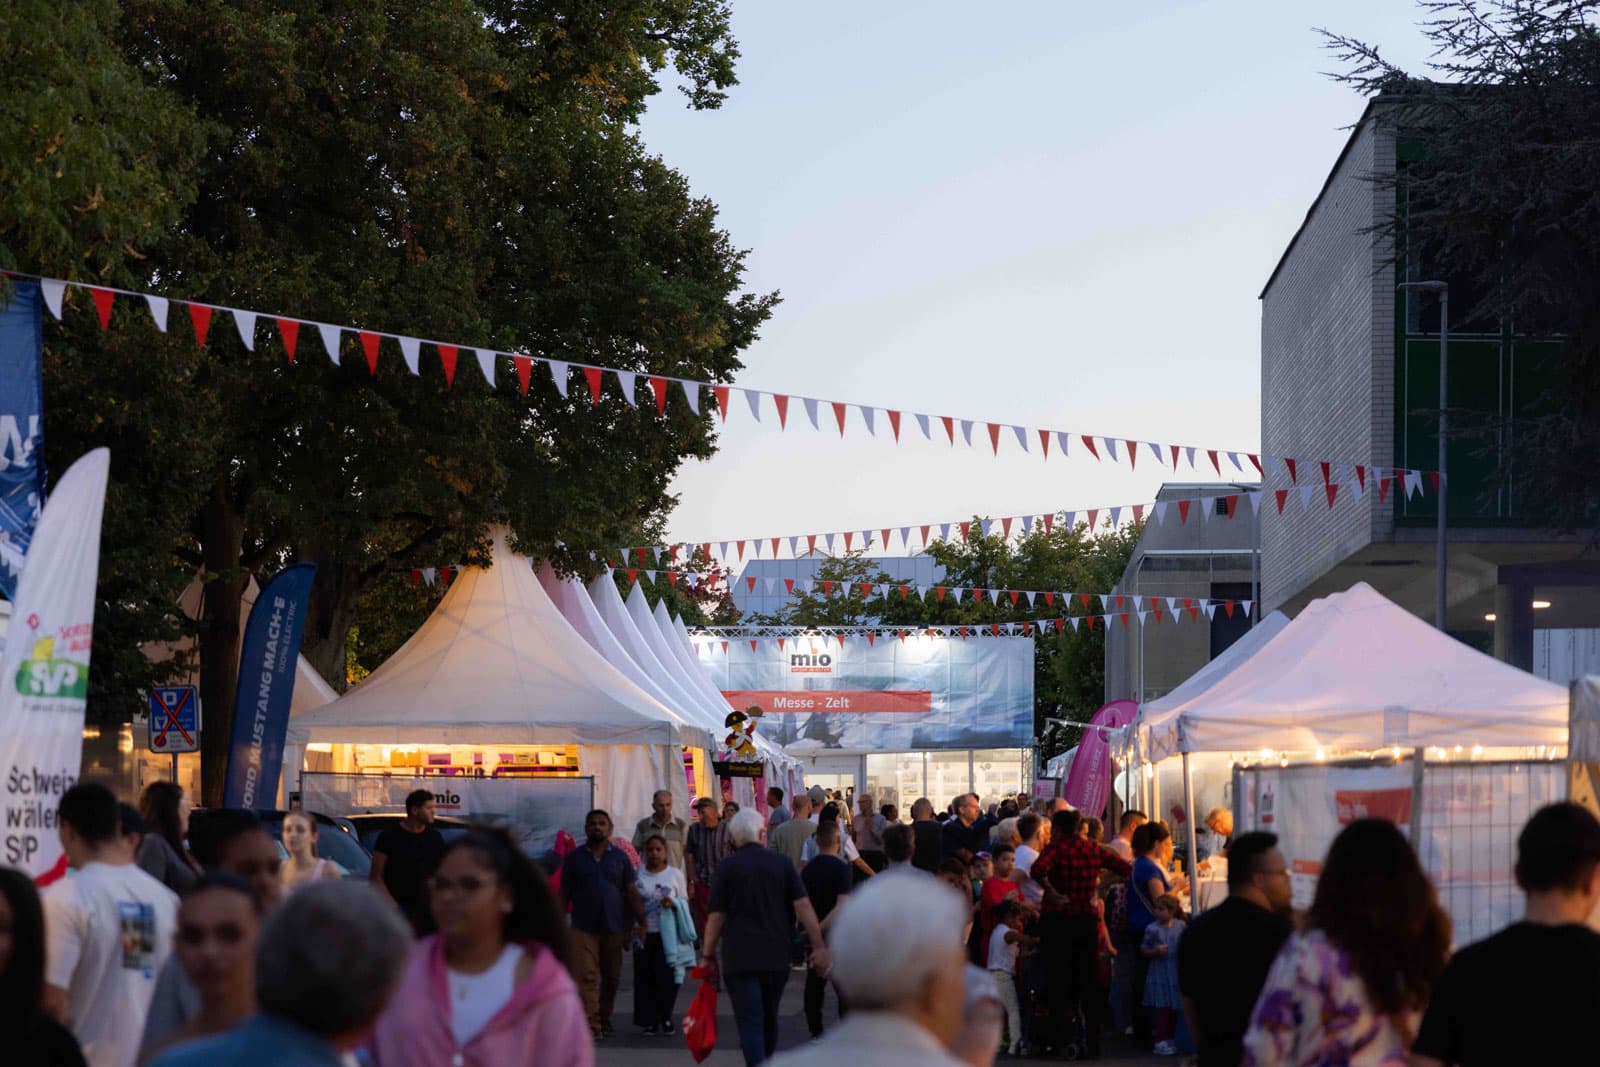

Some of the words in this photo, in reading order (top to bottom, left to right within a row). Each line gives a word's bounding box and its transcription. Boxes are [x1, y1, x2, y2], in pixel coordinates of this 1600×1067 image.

[791, 648, 832, 666] mio
[773, 697, 814, 709] Messe
[825, 696, 850, 709] Zelt
[249, 671, 273, 768] MUSTANG
[434, 789, 461, 804] mio
[5, 835, 38, 864] SP
